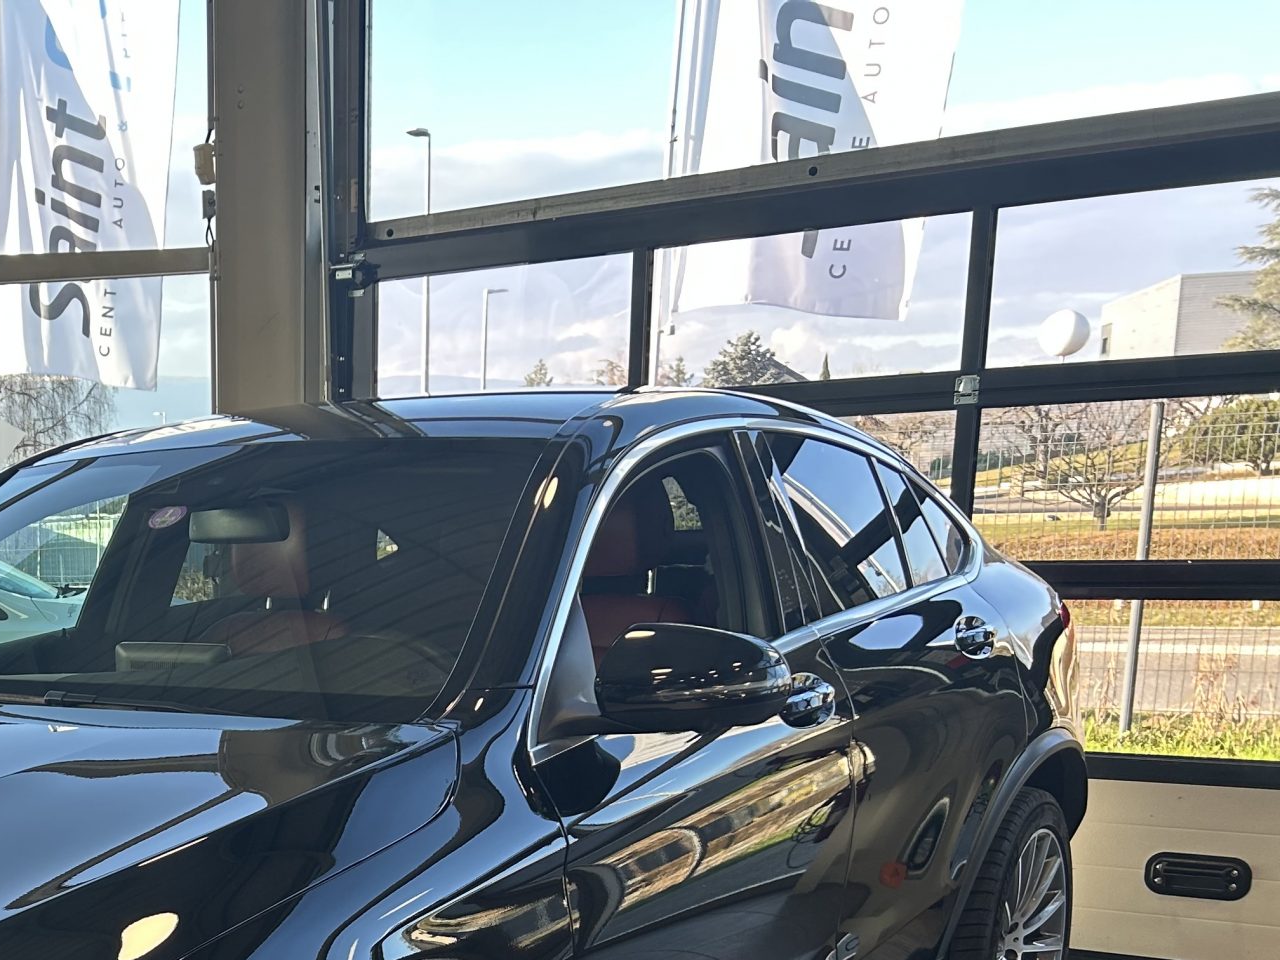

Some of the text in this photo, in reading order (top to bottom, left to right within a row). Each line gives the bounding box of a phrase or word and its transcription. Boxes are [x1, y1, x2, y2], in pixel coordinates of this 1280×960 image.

[861, 6, 890, 104] AUTO
[98, 280, 117, 357] CENT
[111, 157, 126, 229] AUTO
